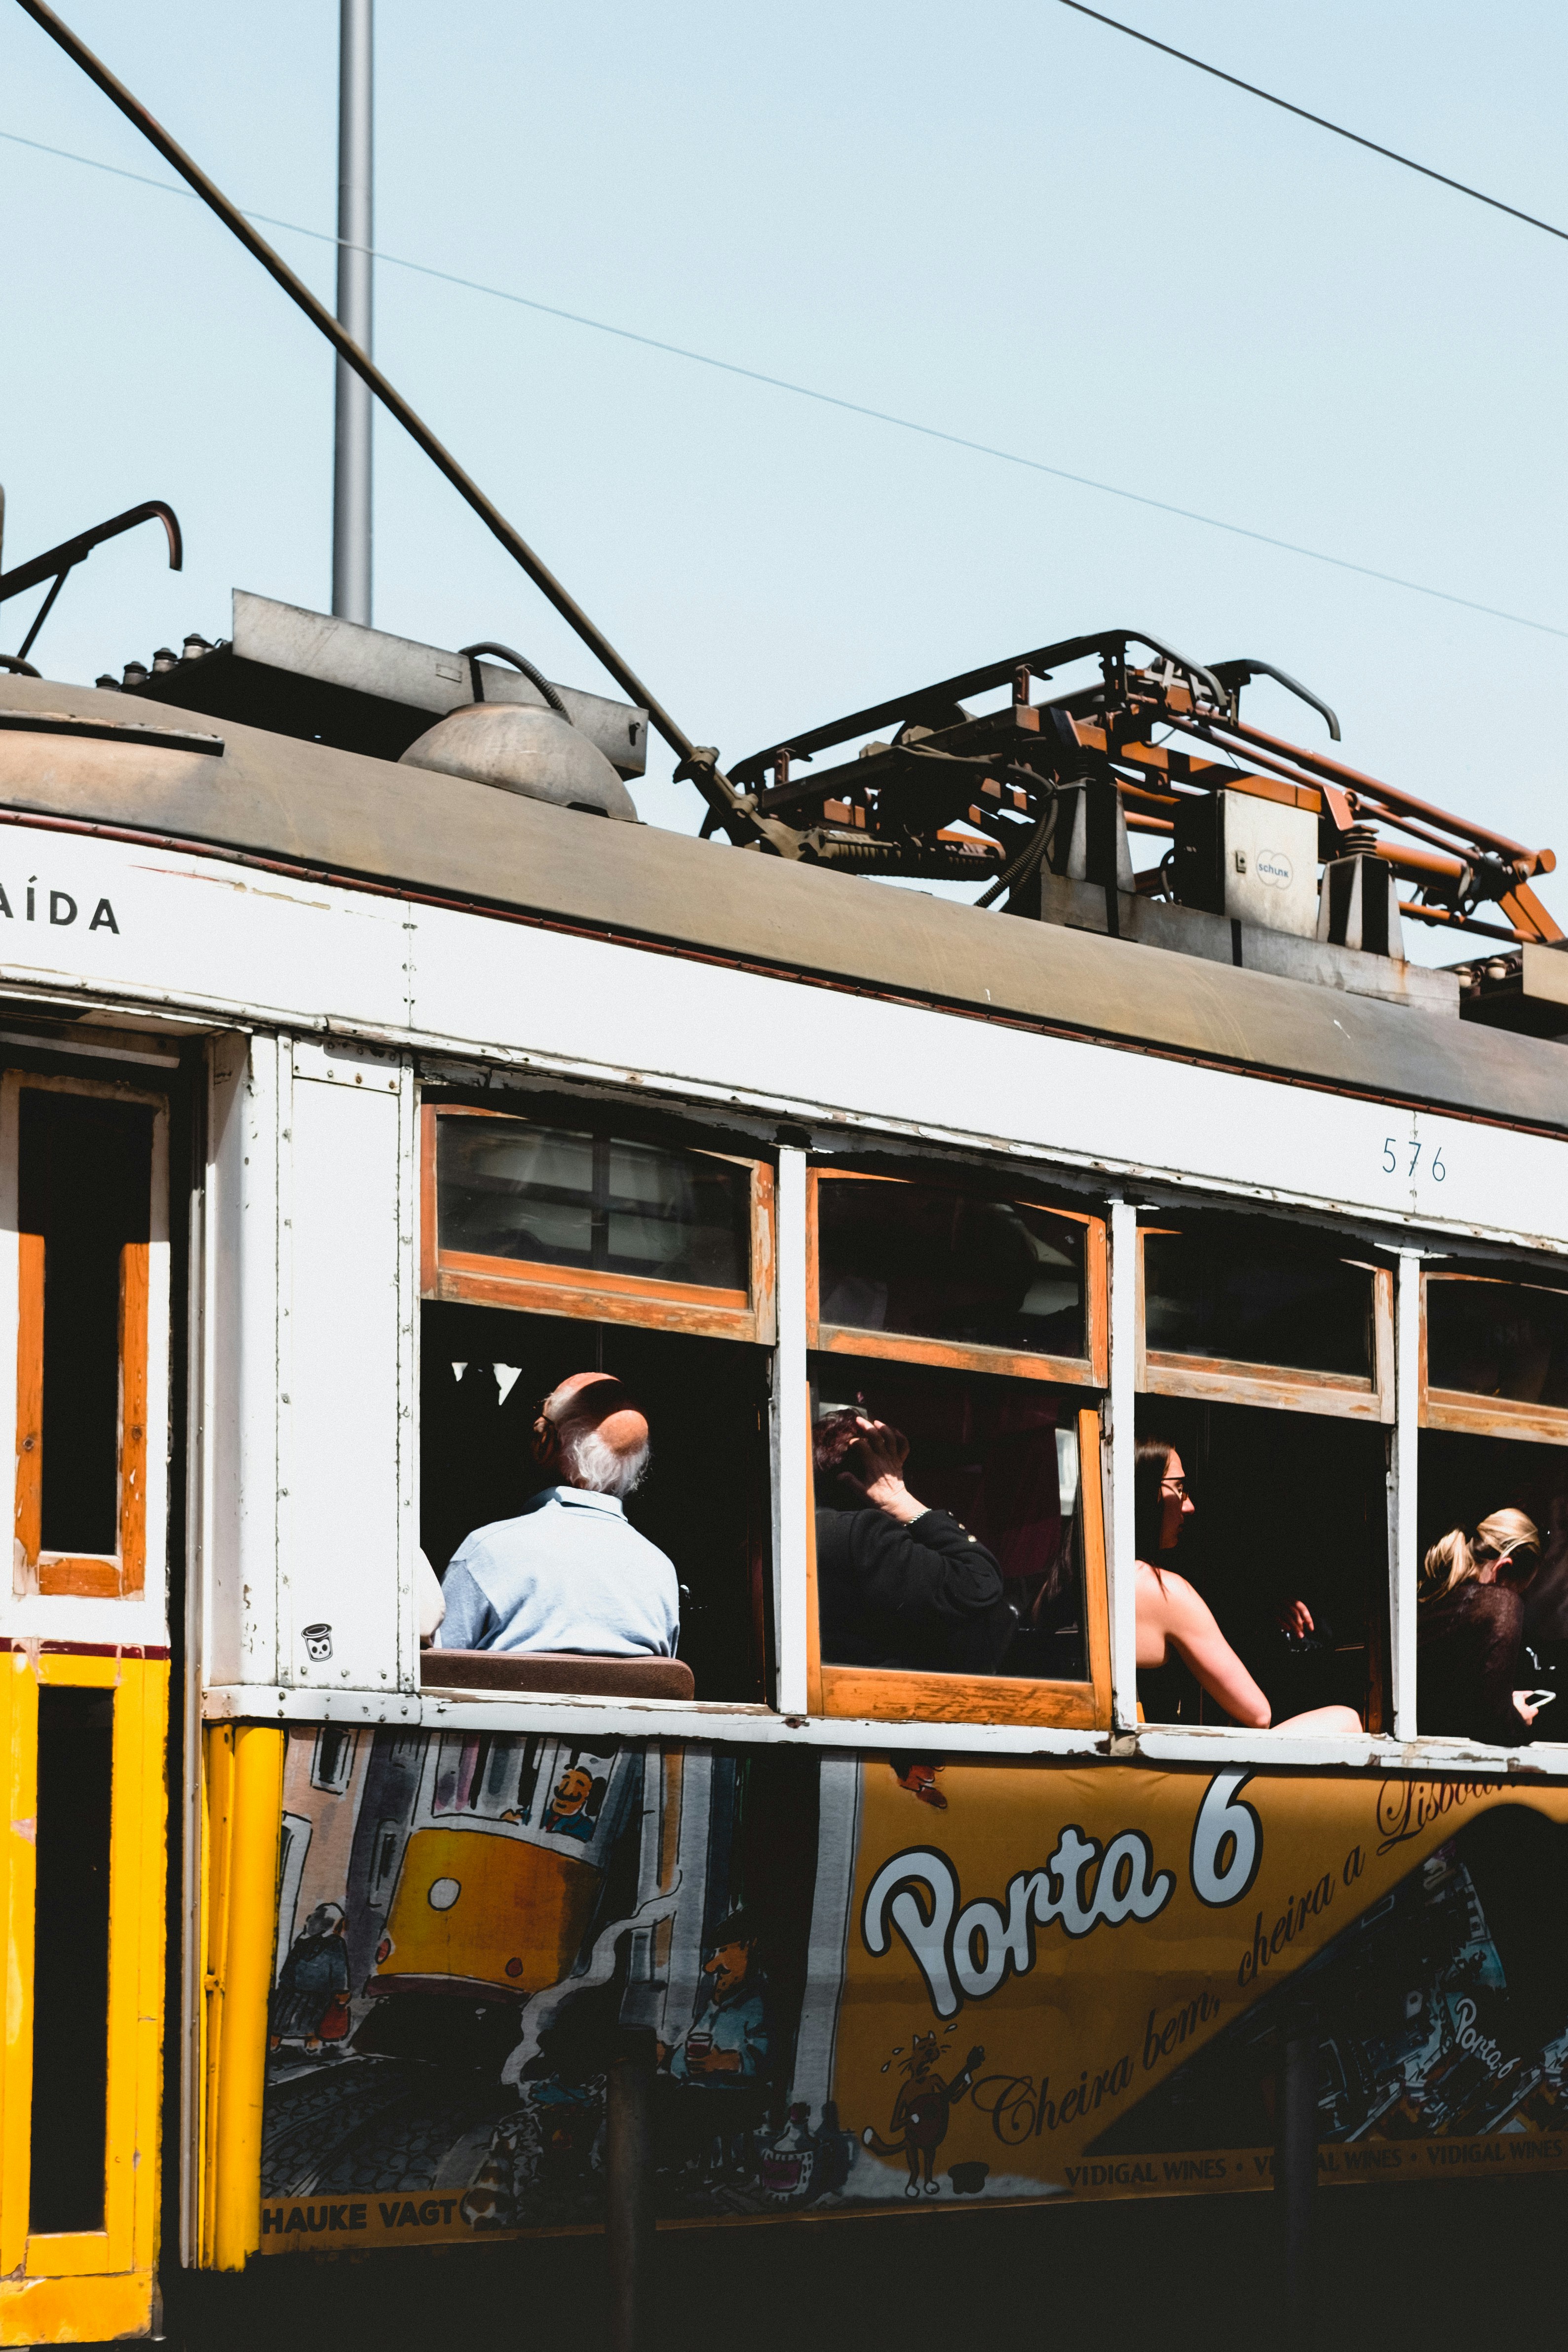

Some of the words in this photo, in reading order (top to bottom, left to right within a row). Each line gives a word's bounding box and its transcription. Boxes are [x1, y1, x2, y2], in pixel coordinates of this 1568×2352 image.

[1382, 1138, 1446, 1181] 576
[861, 1824, 1177, 2021] Porta
[1189, 1766, 1263, 1908] 6
[971, 2054, 1134, 2145] Cheira
[1143, 1992, 1221, 2071] bem,
[1238, 1872, 1335, 1987] cheira
[1343, 1844, 1366, 1886] a
[1065, 2163, 1157, 2187] VIDIGAL
[1163, 2159, 1227, 2180] WINES
[1254, 2152, 1340, 2175] VIAL
[1344, 2149, 1402, 2169] WINES
[1426, 2143, 1505, 2165] VIDIGAL
[1509, 2139, 1563, 2159] WINES
[262, 2203, 366, 2234] HAUKE
[379, 2199, 457, 2227] VAGT
